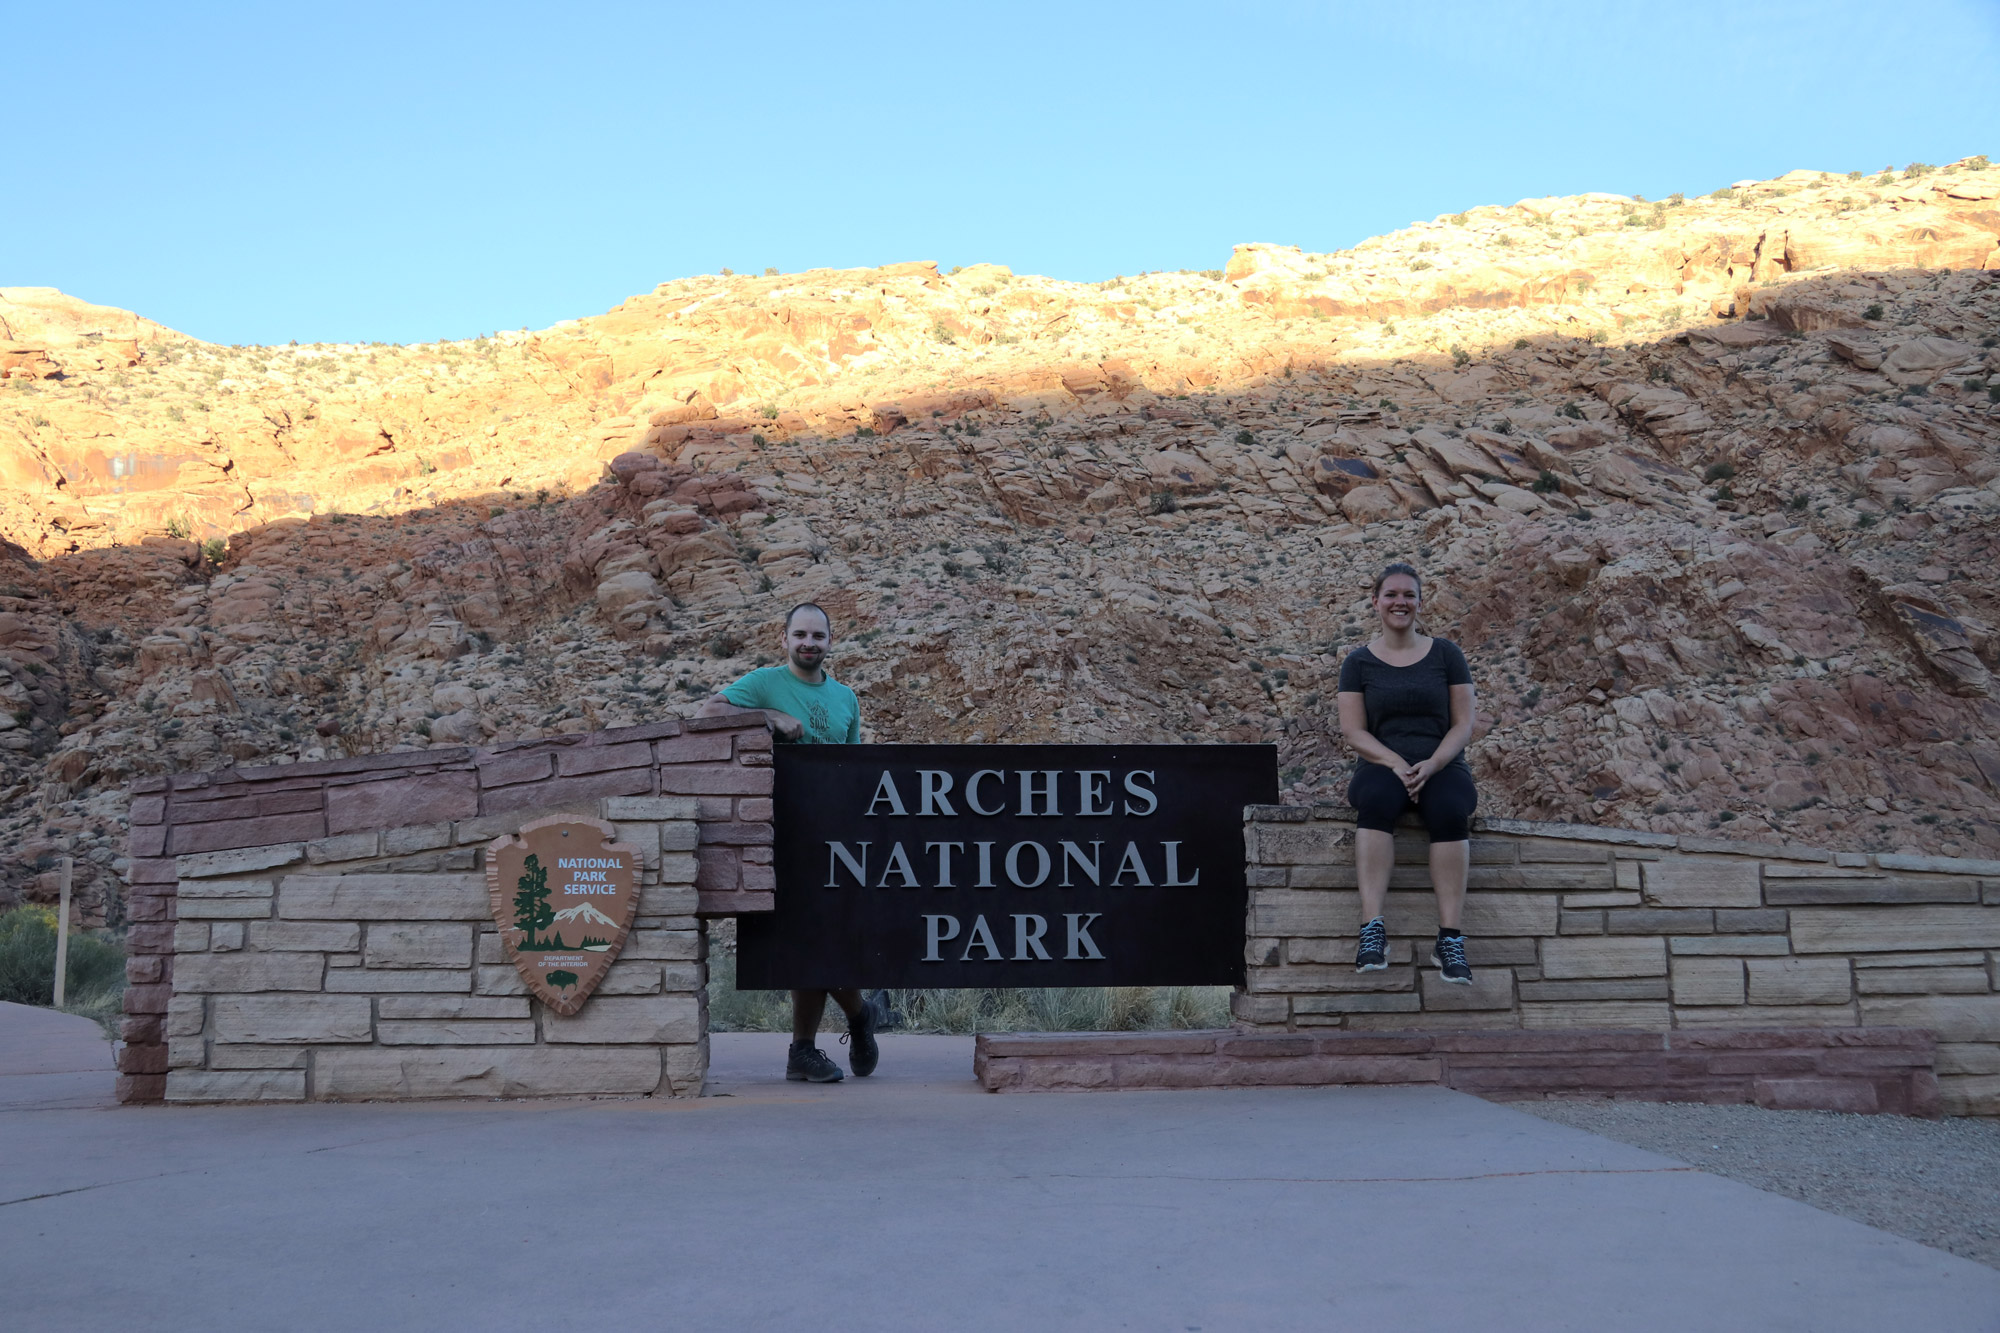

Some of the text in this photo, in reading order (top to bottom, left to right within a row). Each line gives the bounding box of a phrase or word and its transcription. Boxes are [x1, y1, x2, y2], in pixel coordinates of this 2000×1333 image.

[864, 769, 1158, 817] ARCHES
[558, 857, 623, 869] NATIONAL
[573, 871, 607, 882] PARK
[823, 840, 1199, 888] NATIONAL
[564, 884, 616, 895] SERVICE
[920, 913, 1106, 961] PARK
